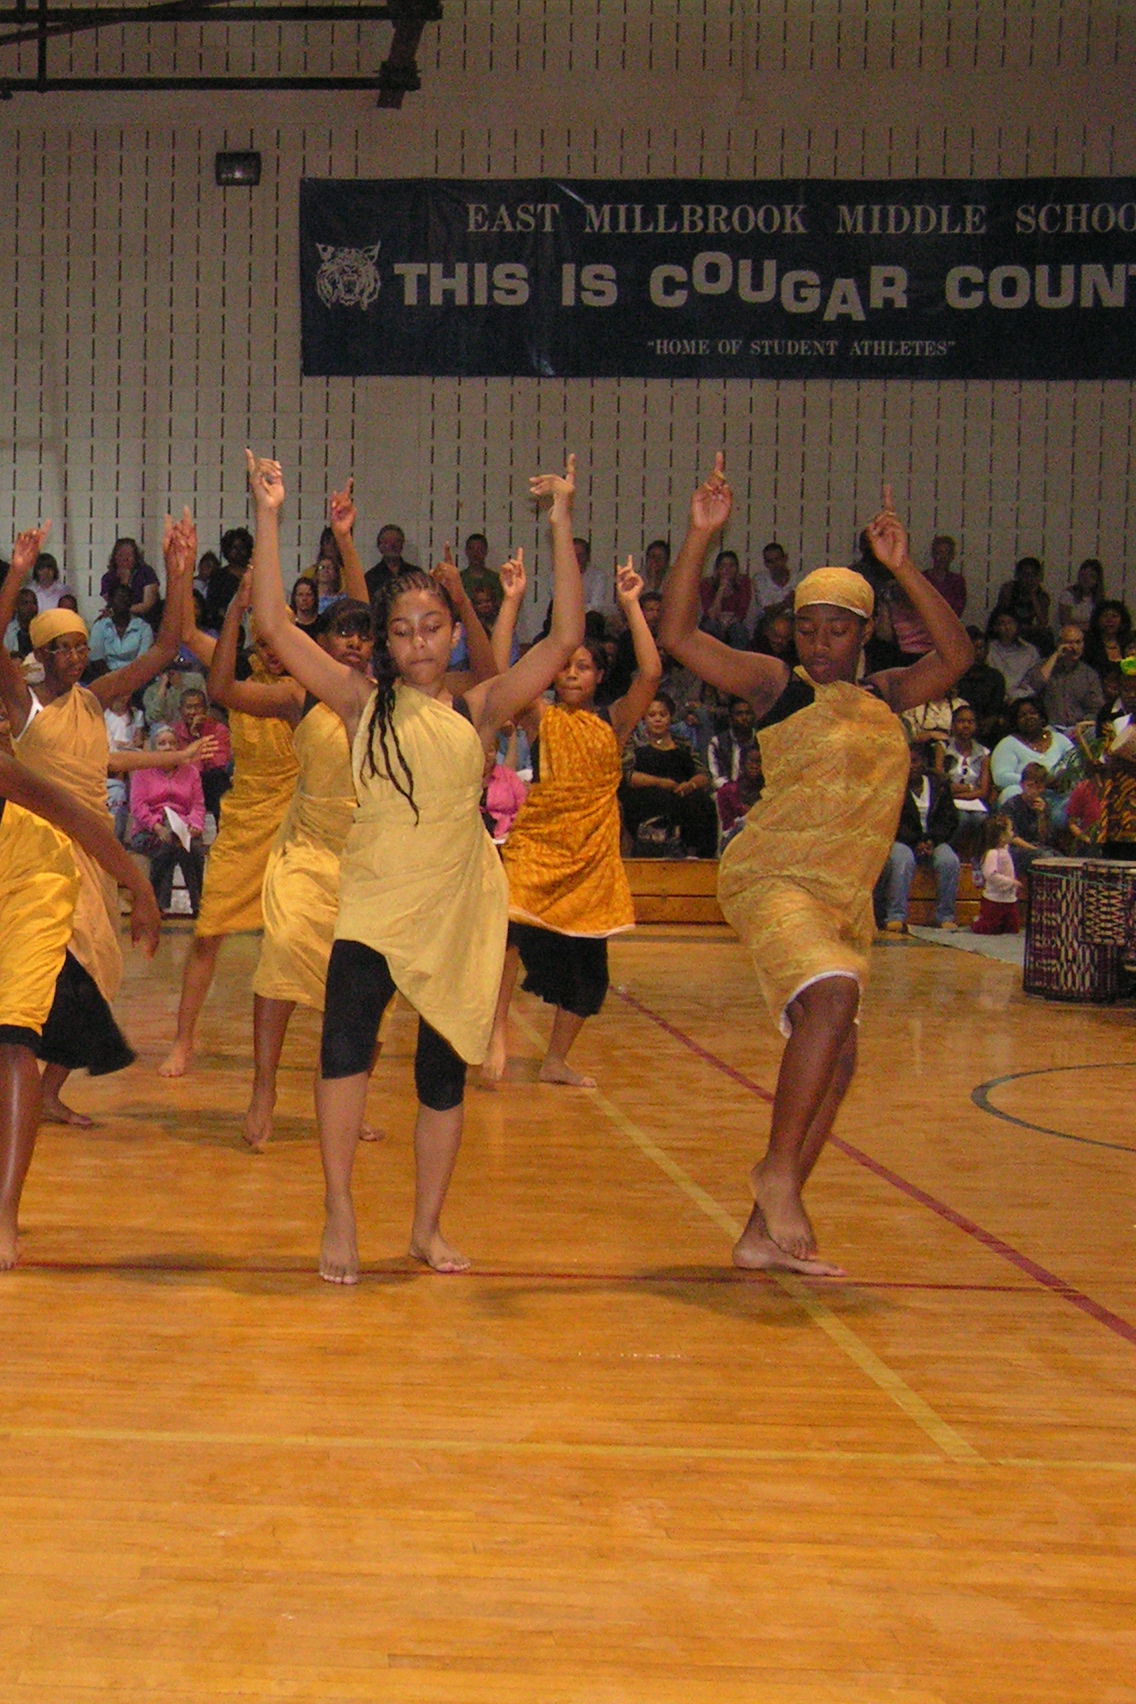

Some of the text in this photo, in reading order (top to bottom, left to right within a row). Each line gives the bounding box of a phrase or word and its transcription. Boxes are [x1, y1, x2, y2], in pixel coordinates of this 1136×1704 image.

[467, 202, 560, 233] EAST
[583, 203, 809, 235] MILLBROOK
[836, 204, 987, 235] MIDDLE
[393, 250, 1136, 322] THIS IS COUGAR COUN
[717, 339, 744, 356] OF
[750, 339, 839, 356] STUDENT
